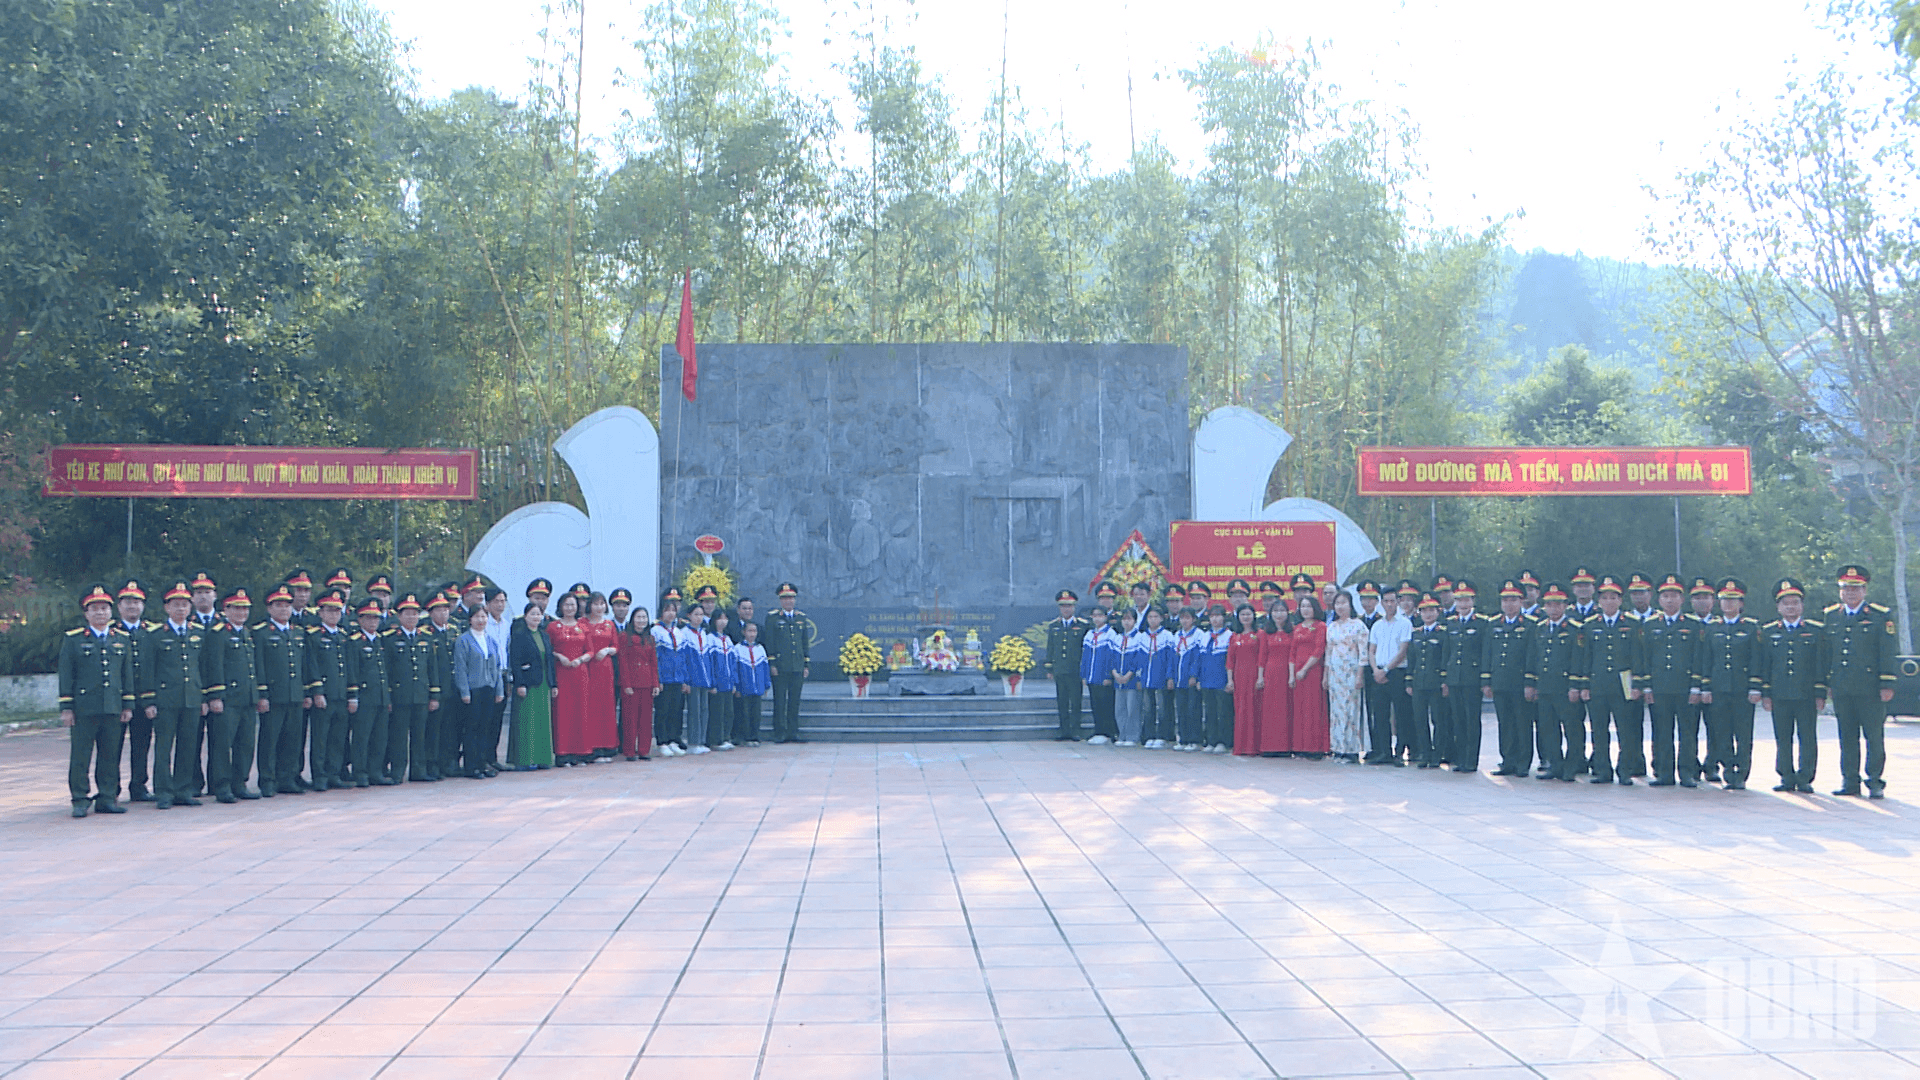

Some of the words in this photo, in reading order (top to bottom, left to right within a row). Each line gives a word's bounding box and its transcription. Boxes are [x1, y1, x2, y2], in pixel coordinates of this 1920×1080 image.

[67, 458, 84, 481] YÊU
[88, 462, 100, 481] XE
[104, 461, 125, 482] NHƯ
[127, 462, 149, 483] CON,
[175, 460, 200, 482] XĂNG
[203, 462, 224, 482] NHƯ
[301, 461, 319, 483] KHÓ
[353, 461, 378, 484] HOÀN
[381, 461, 411, 484] THÀNH
[447, 466, 459, 489] VỤ
[1379, 457, 1409, 482] MỞ
[1415, 459, 1477, 482] ĐƯỜNG
[1484, 459, 1513, 482] MÀ
[1519, 458, 1565, 484] TIẾN,
[1571, 459, 1620, 482] ĐÁNH
[1627, 463, 1668, 486] ĐỊCH
[1675, 459, 1705, 482] MÀ
[1711, 463, 1729, 482] ĐI
